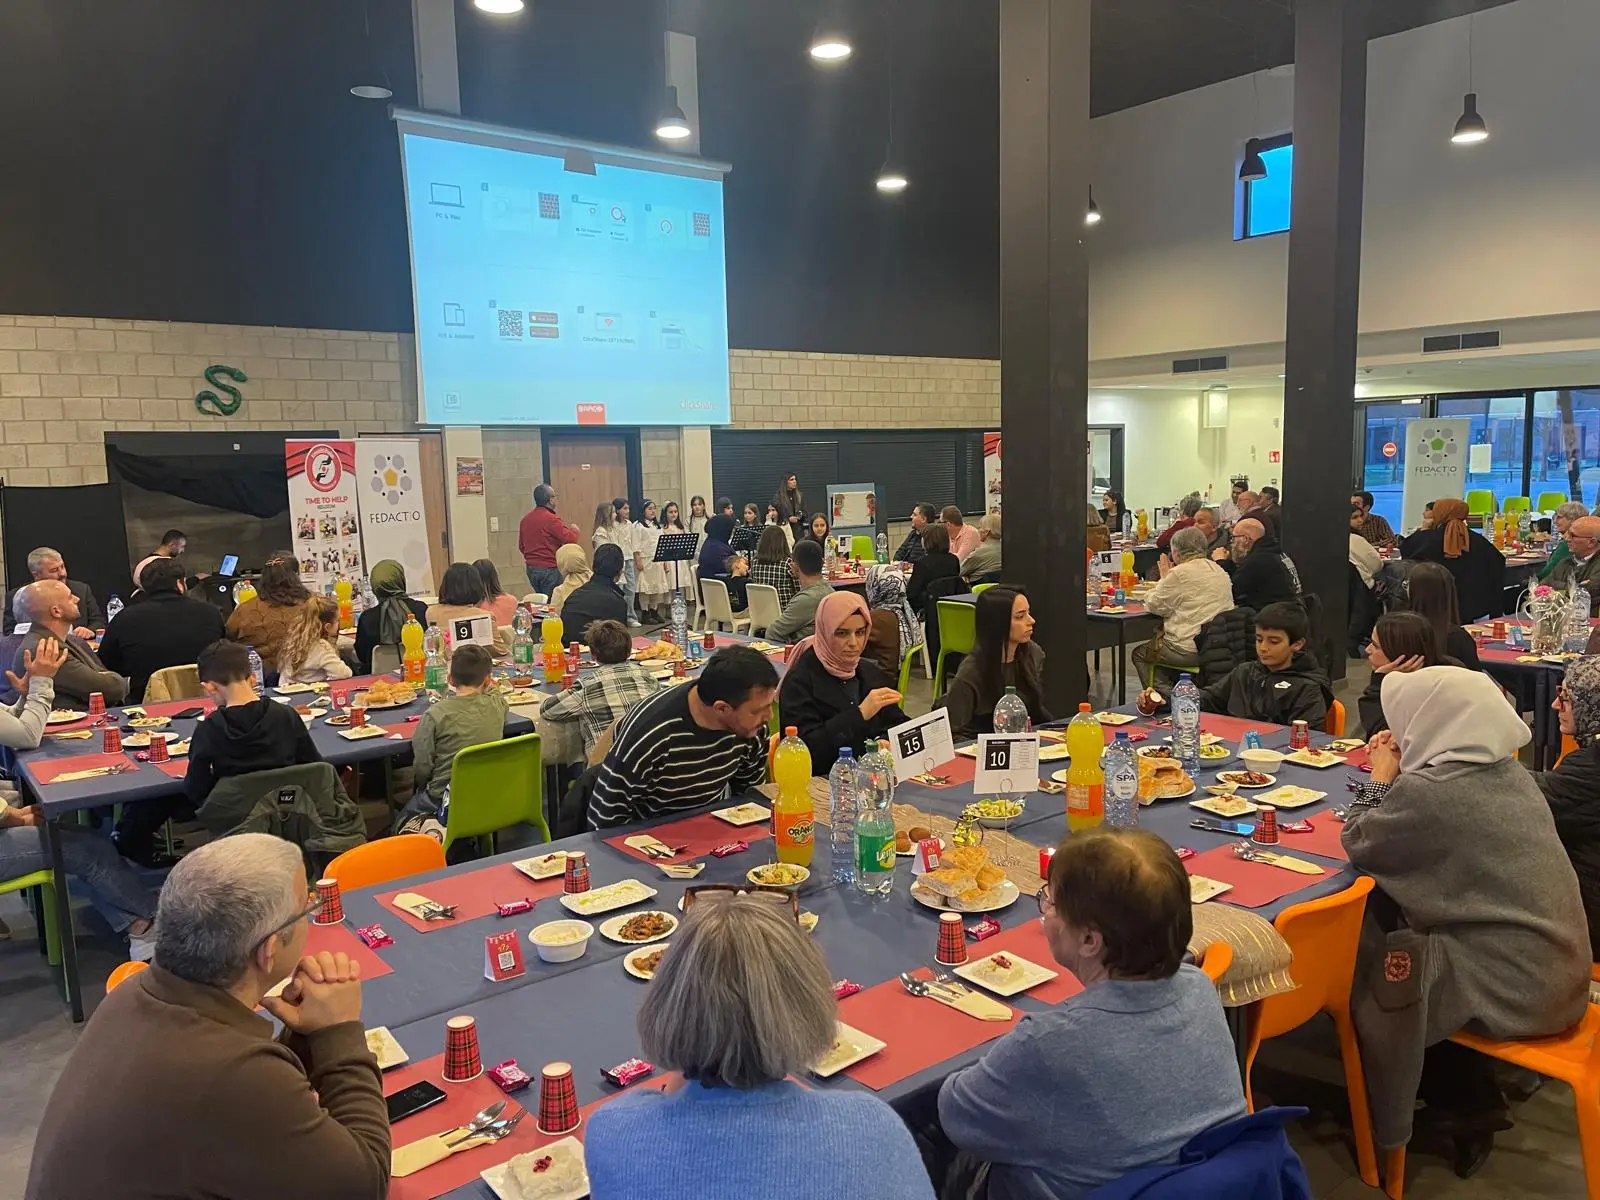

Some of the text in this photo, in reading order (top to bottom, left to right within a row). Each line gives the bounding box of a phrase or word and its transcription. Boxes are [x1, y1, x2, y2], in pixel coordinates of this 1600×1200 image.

[460, 626, 468, 638] 9
[904, 736, 921, 755] 15
[990, 751, 1006, 767] 10
[1116, 774, 1136, 782] SPA
